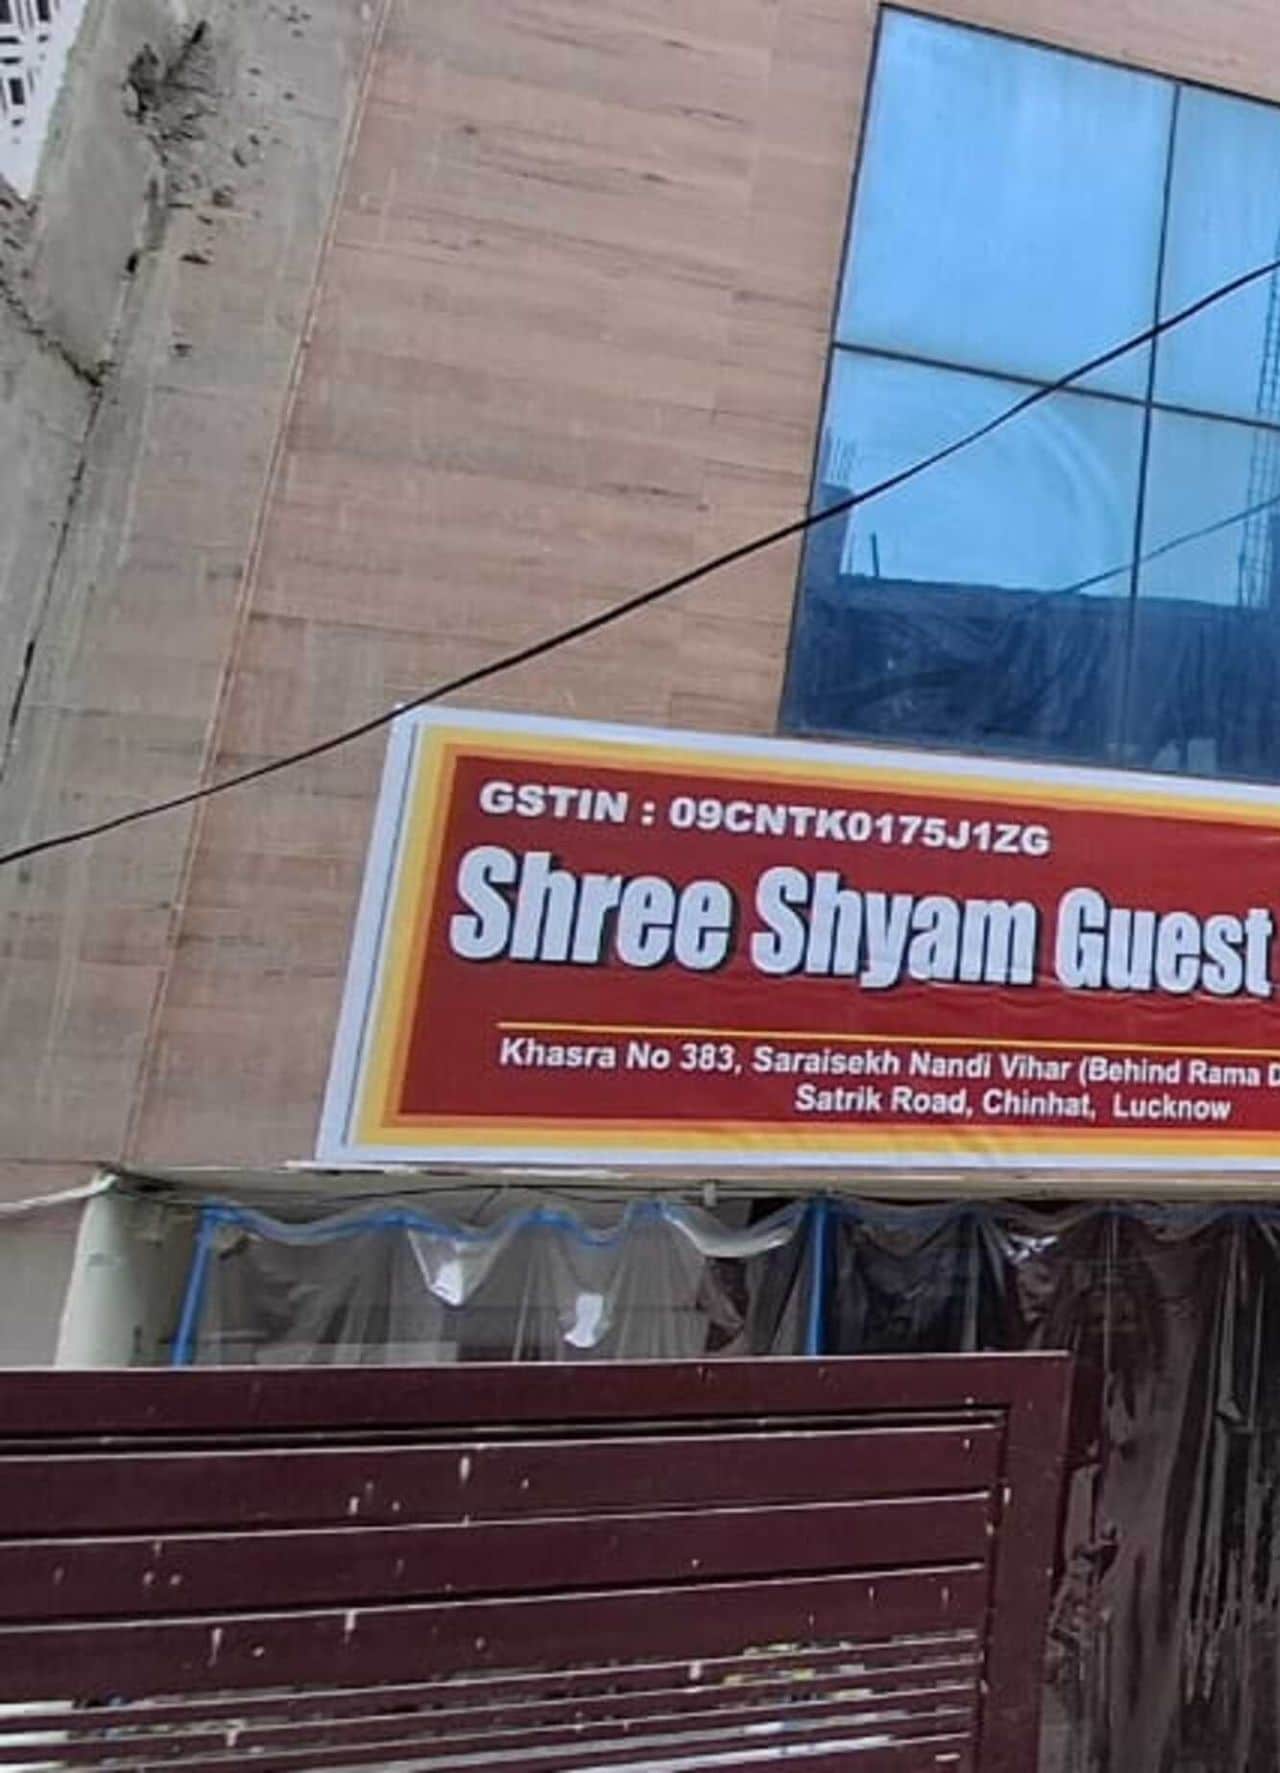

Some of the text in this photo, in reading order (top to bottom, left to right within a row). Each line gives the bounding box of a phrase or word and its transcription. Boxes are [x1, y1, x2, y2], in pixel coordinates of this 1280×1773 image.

[479, 780, 1051, 855] GSTIN : 09CNTK0175J1ZG
[448, 846, 734, 971] Shree
[751, 866, 1036, 988] Shyam
[1055, 886, 1273, 996] Guest
[499, 1037, 616, 1069] Khasra
[625, 1043, 671, 1069] No
[679, 1042, 742, 1074] 383,
[752, 1045, 900, 1075] Saraisekh
[909, 1050, 991, 1078] Nandi
[1000, 1055, 1071, 1081] Vihar
[1078, 1056, 1181, 1086] (Behind
[1188, 1059, 1261, 1087] Rama
[795, 1083, 1231, 1121] Satrik Road, Chinhat, Lucknow
